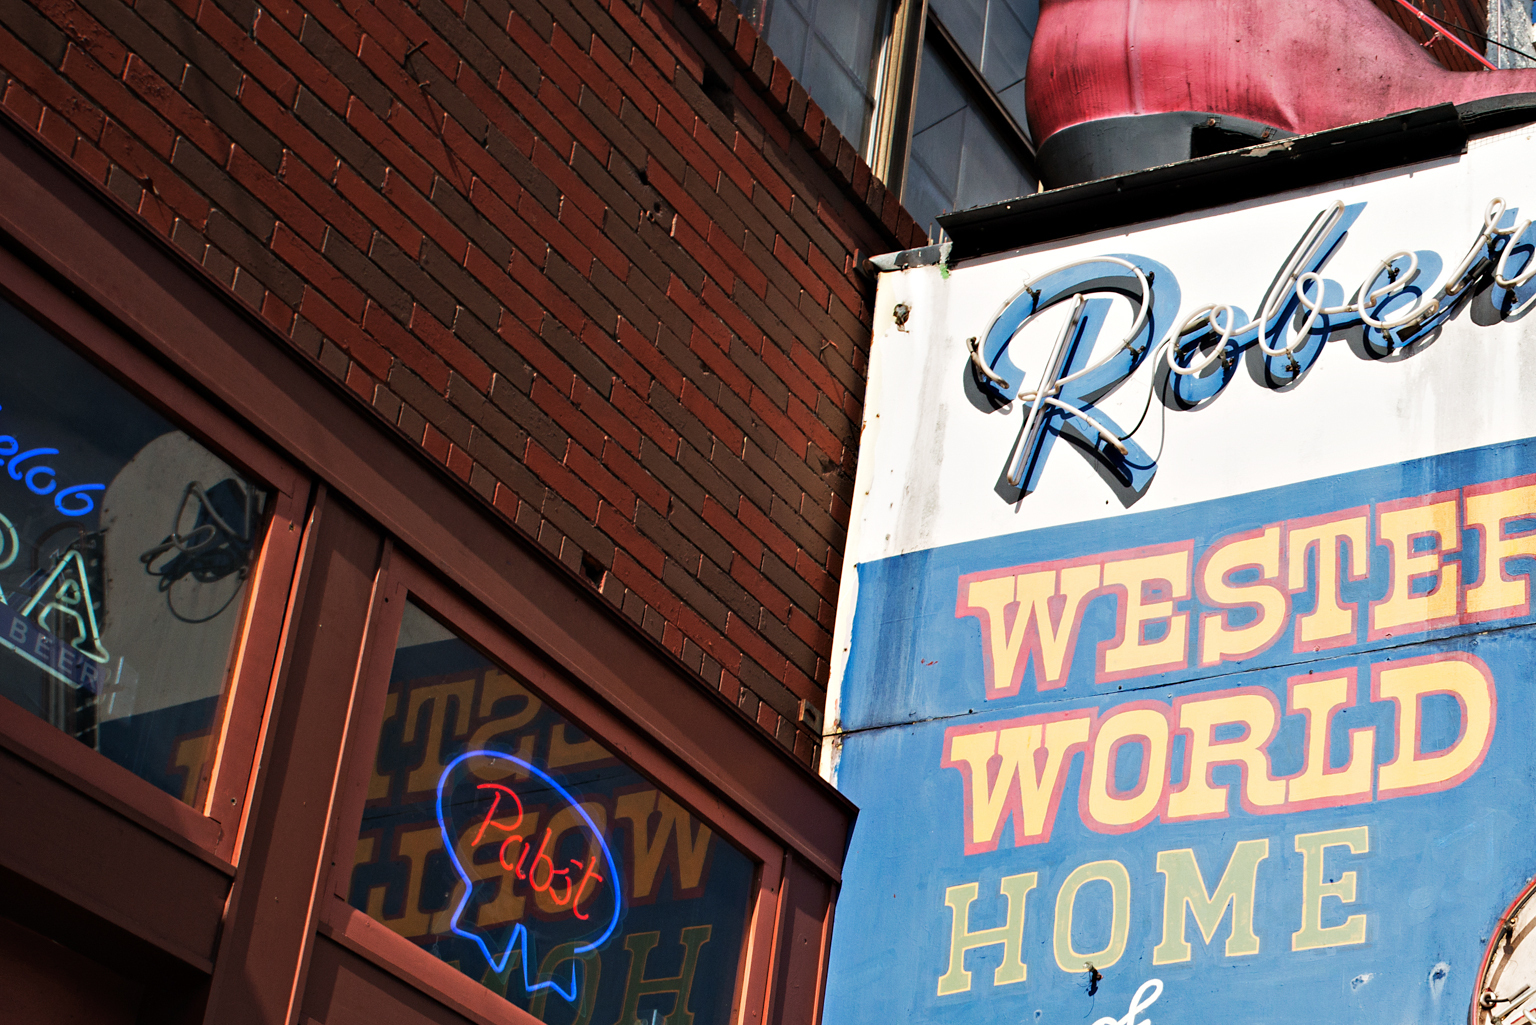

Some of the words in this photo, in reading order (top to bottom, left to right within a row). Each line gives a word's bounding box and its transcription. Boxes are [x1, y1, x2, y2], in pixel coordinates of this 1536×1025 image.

[9, 616, 99, 690] BEER
[941, 651, 1497, 856] WORLD
[471, 783, 604, 920] Pabst
[937, 825, 1370, 996] HOME
